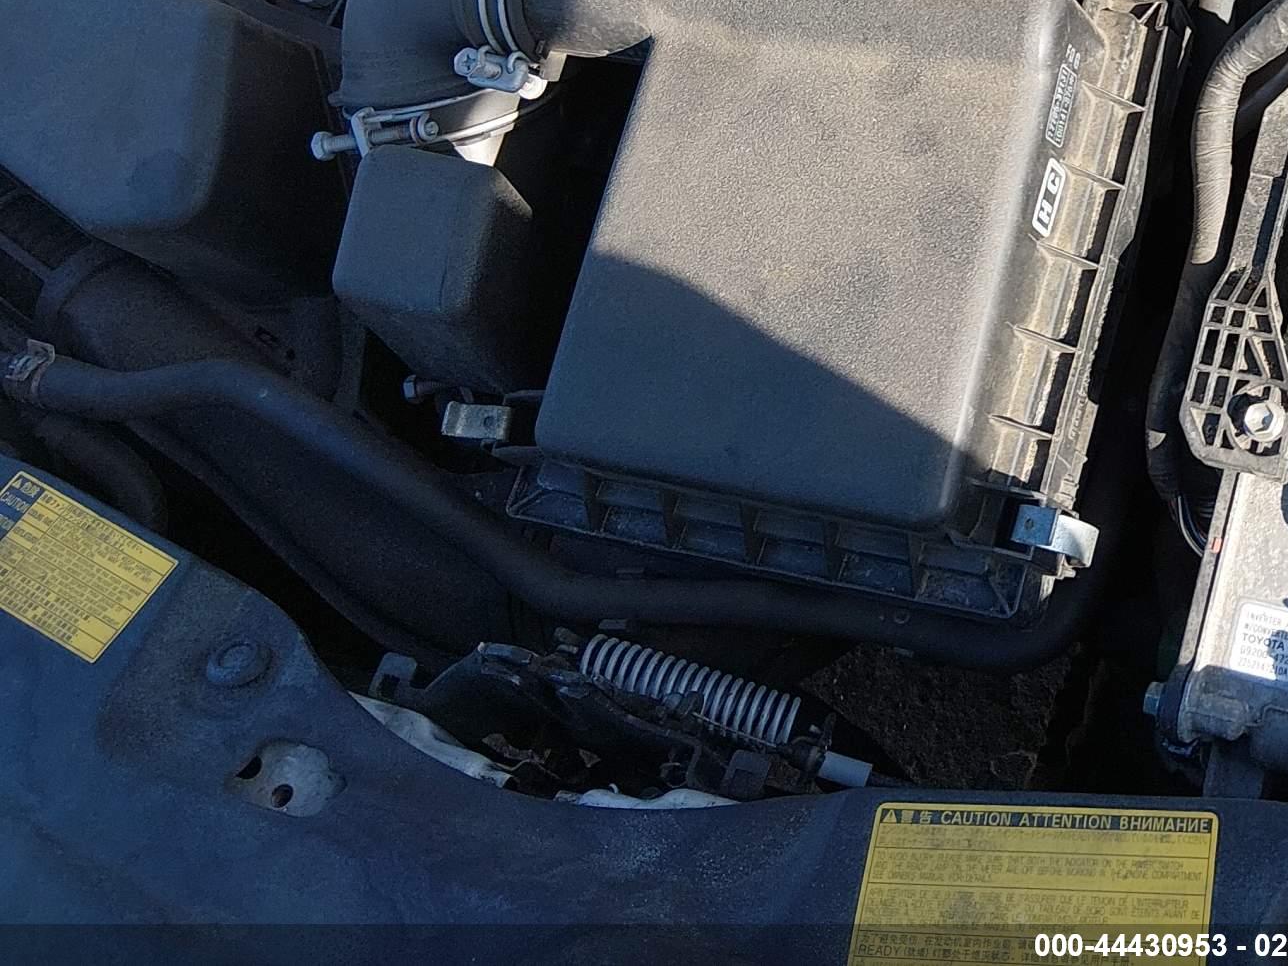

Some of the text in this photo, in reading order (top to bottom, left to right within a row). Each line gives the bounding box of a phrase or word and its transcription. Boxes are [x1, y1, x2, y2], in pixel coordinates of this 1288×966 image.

[1242, 633, 1286, 651] TOYOTA
[940, 810, 1011, 826] CAUTION
[1019, 812, 1112, 829] ATTENTION
[1119, 816, 1209, 833] ВНИМАНИЕ
[858, 945, 899, 957] READY
